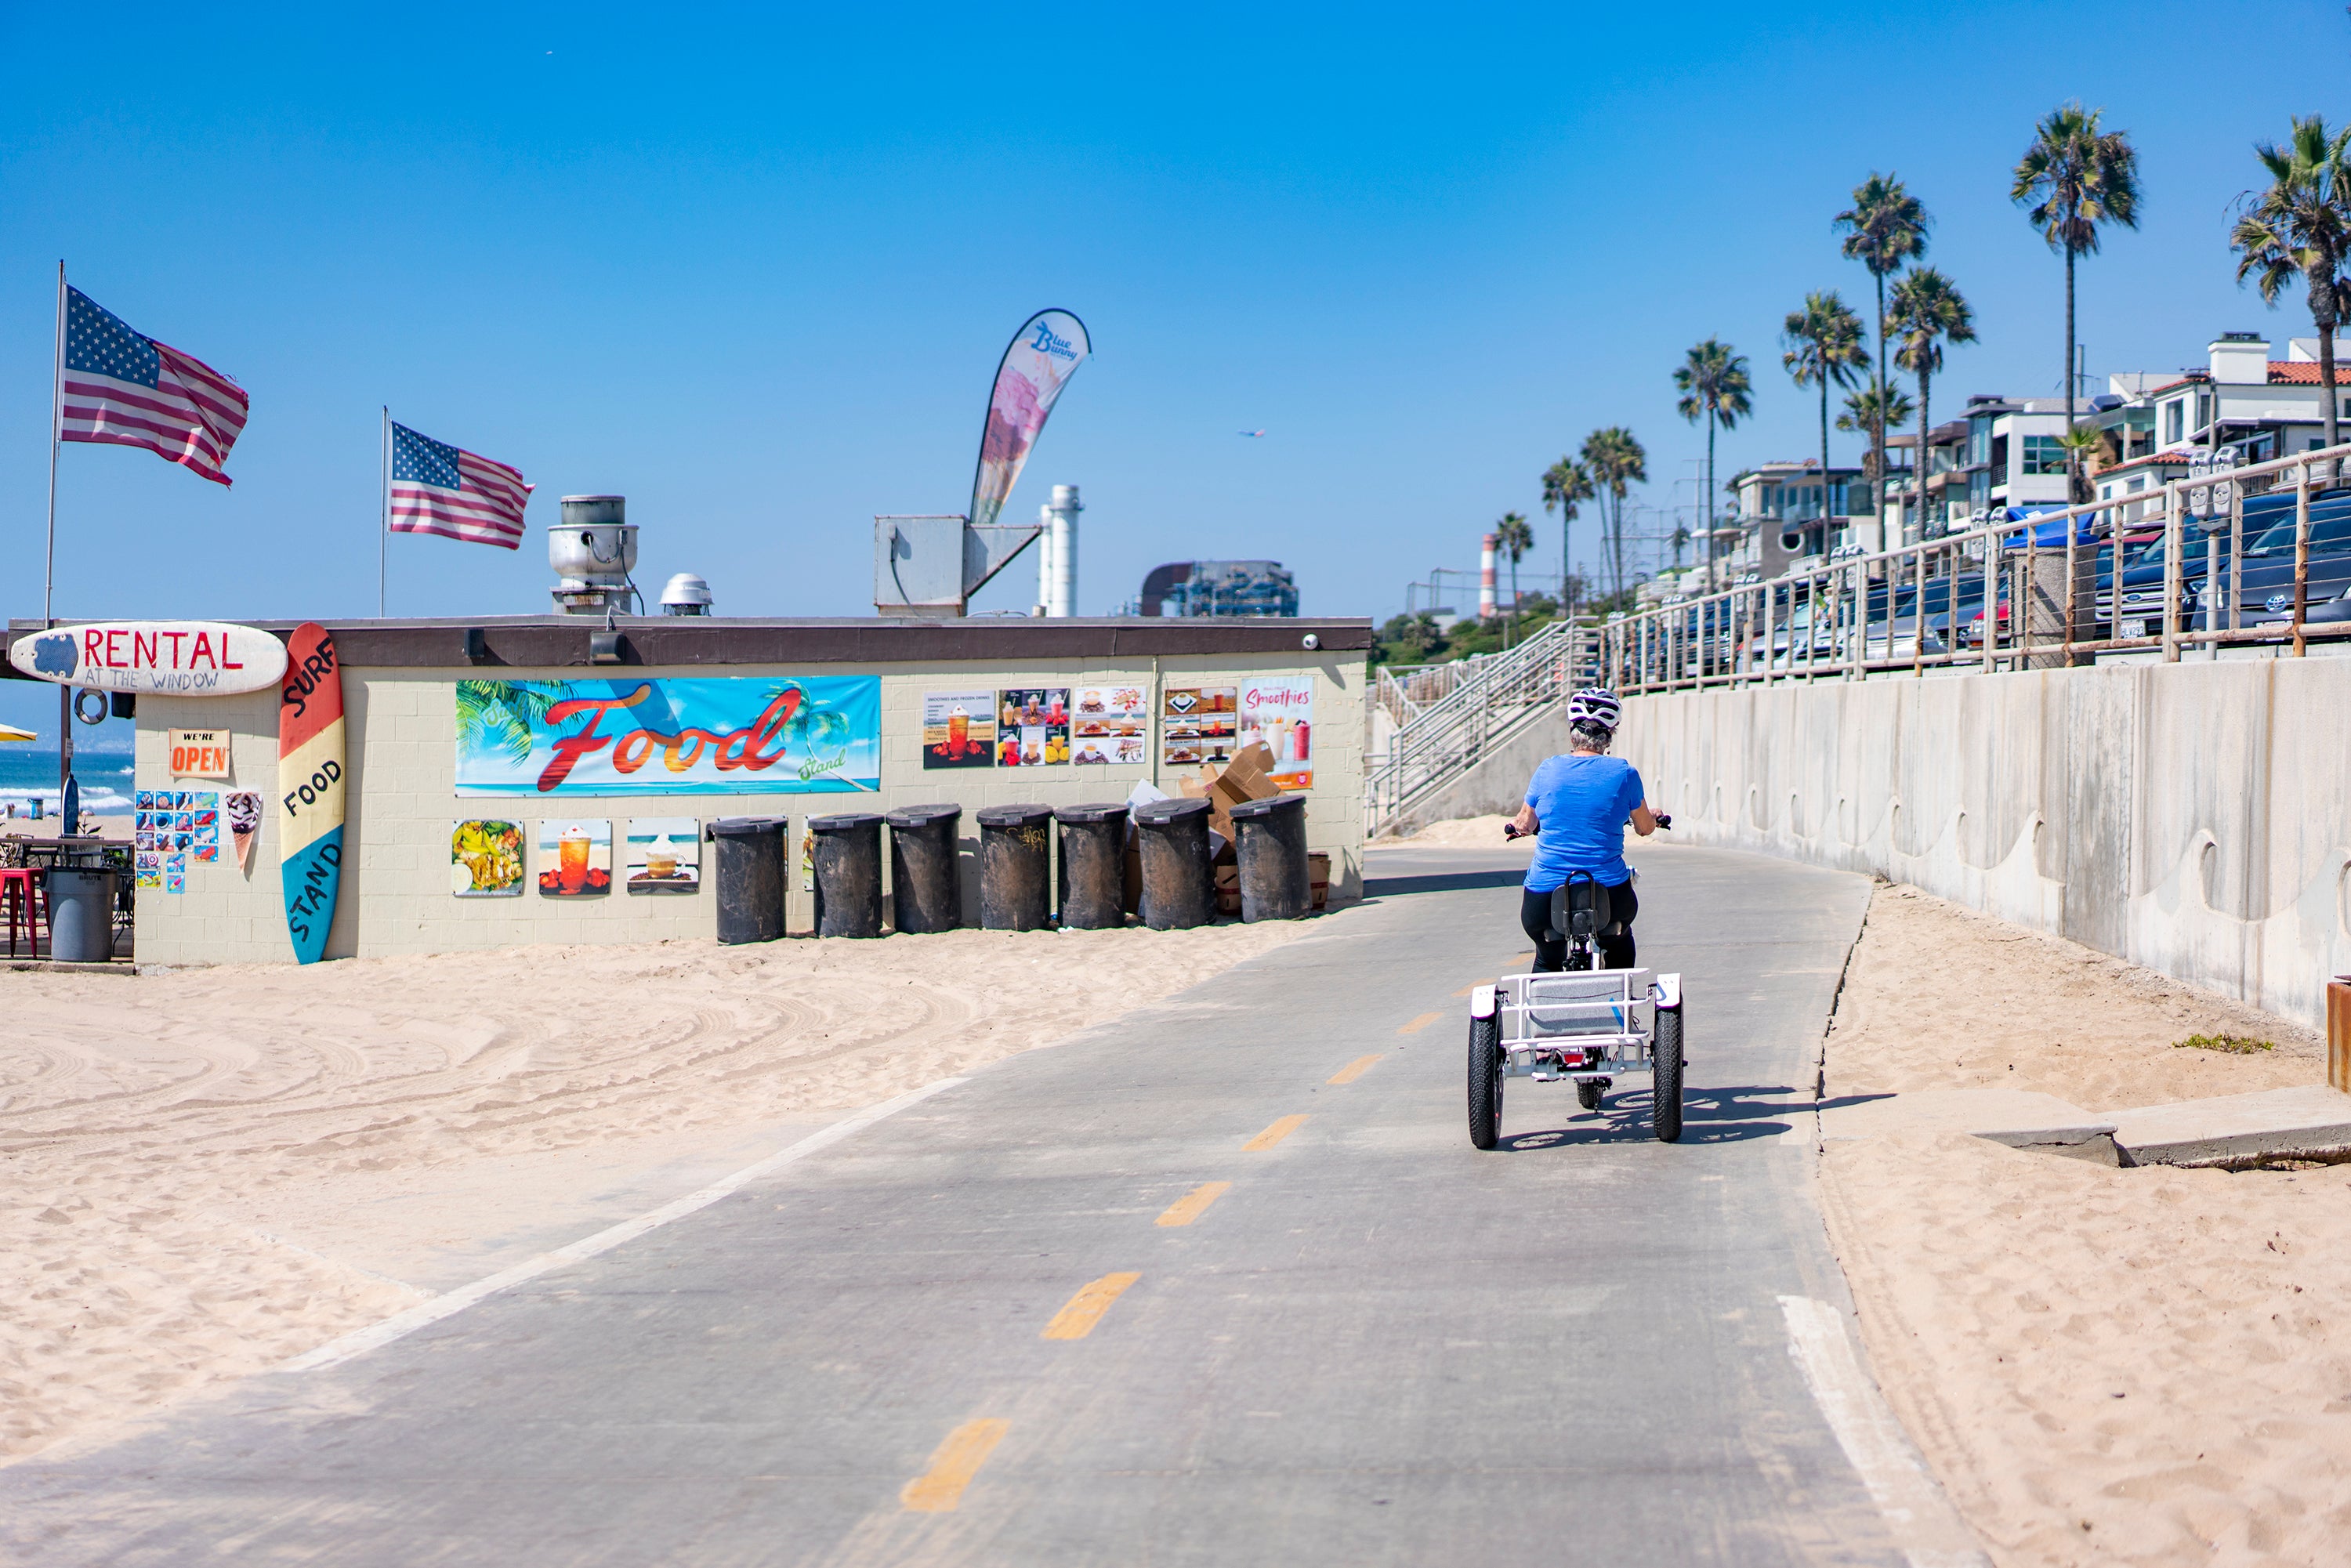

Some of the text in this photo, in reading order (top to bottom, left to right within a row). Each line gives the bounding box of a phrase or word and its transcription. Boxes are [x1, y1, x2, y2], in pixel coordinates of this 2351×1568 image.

[85, 628, 243, 670] RENTAL
[85, 668, 219, 690] AT THE WINDOW
[283, 637, 335, 719] SURF
[484, 693, 526, 726] Surf
[1246, 688, 1310, 709] Smoothies
[537, 683, 802, 792] Food
[172, 746, 226, 772] OPEN
[798, 748, 846, 781] Stand
[283, 759, 342, 817] FOOD
[289, 842, 342, 942] STAND
